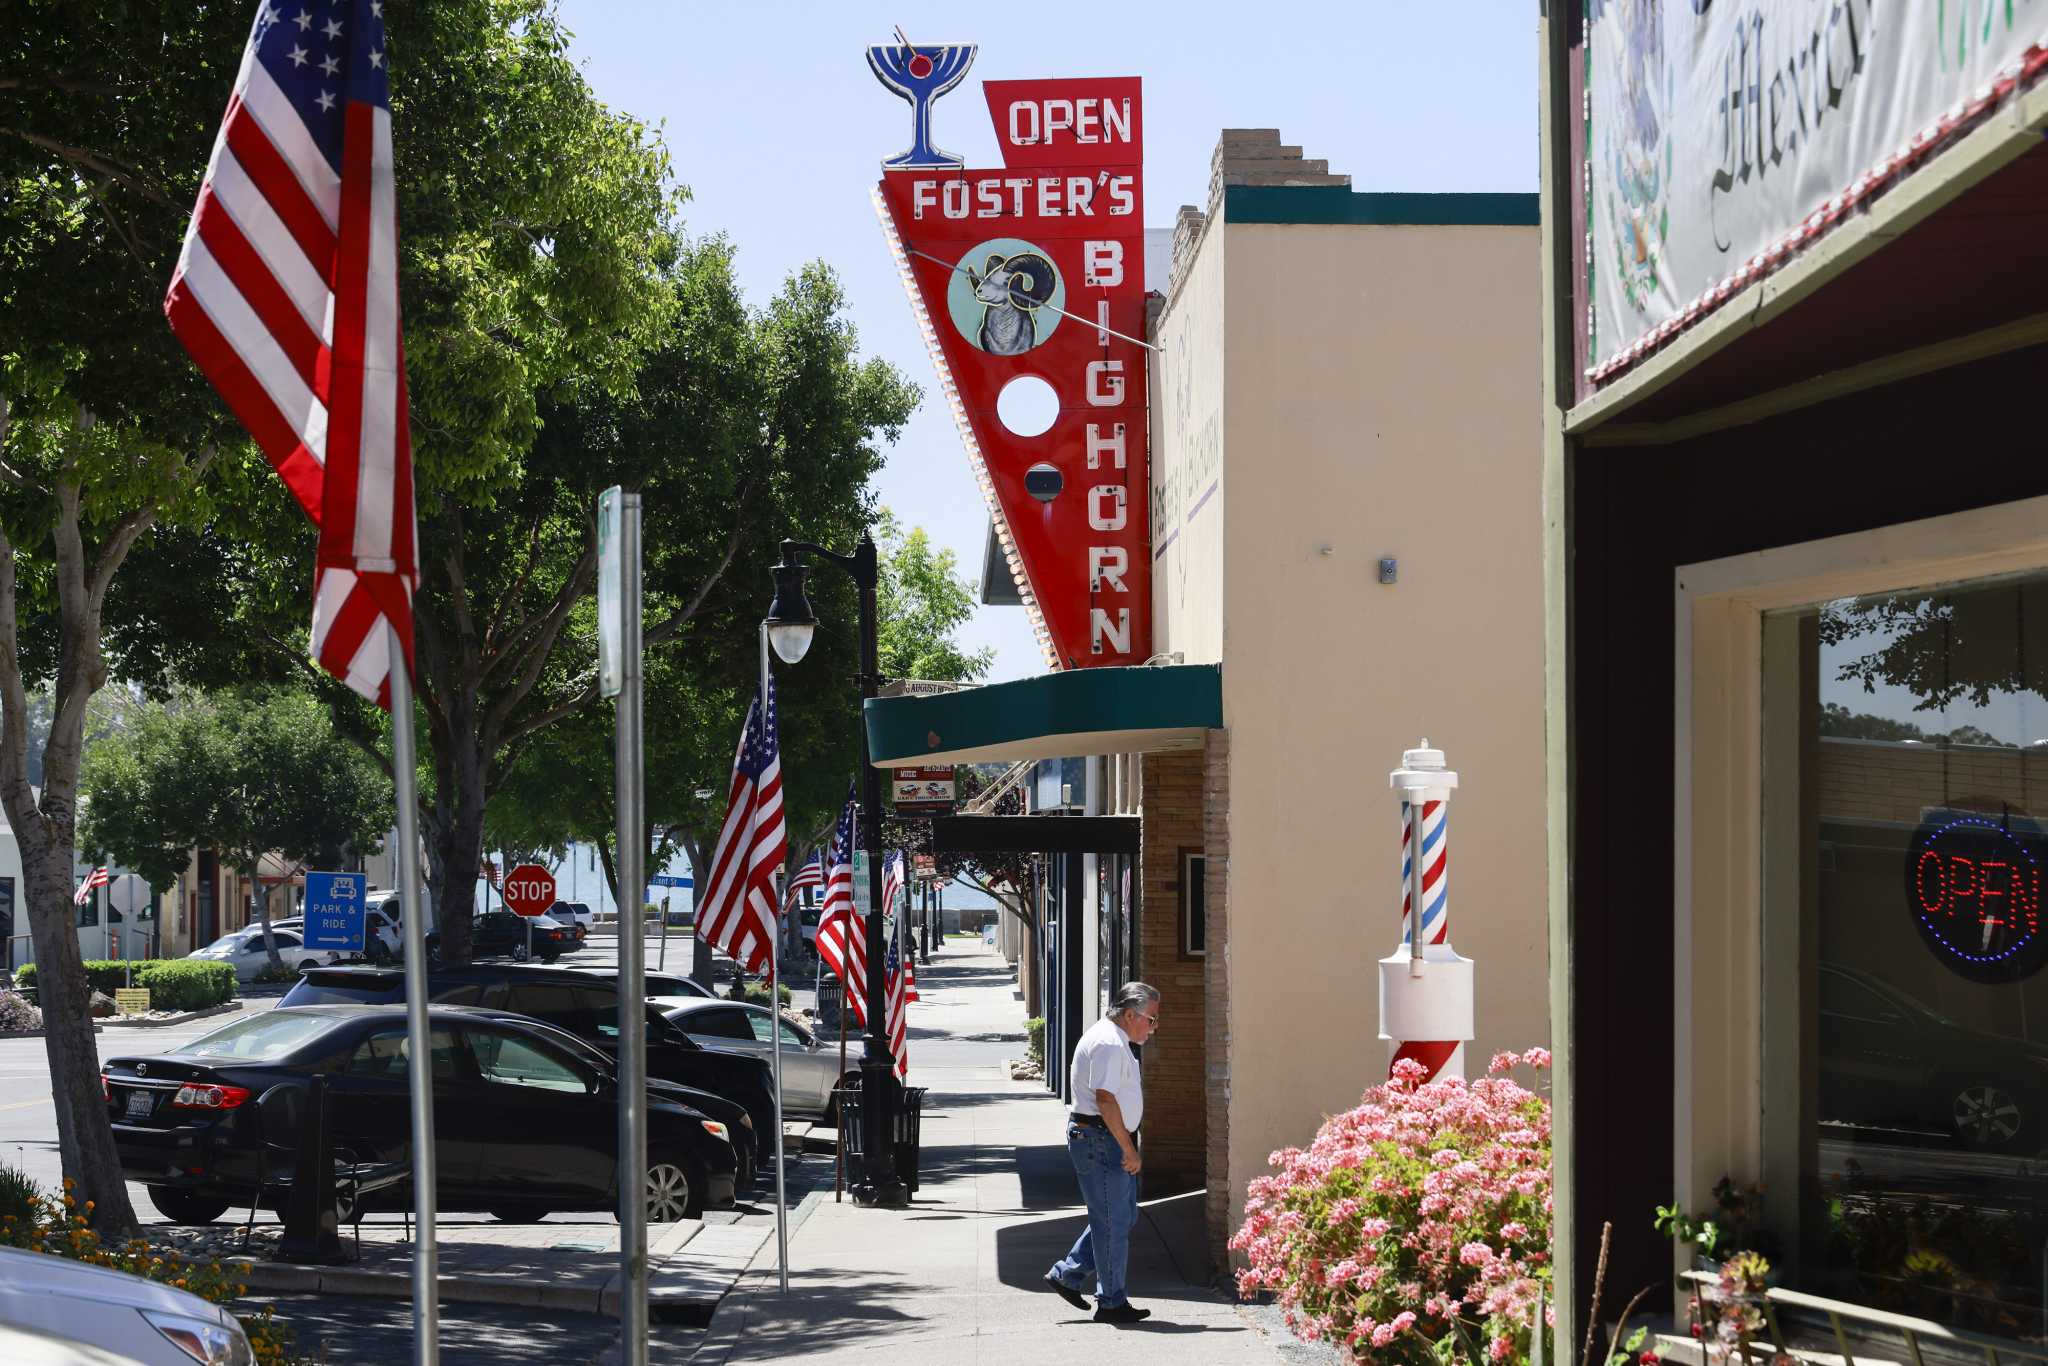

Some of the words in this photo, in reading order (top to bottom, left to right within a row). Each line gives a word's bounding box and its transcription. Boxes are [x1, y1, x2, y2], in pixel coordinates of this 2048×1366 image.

[1009, 98, 1131, 145] OPEN
[914, 171, 1133, 219] FOSTER'S
[1084, 240, 1130, 654] BIGHORN
[313, 904, 341, 914] PARK
[348, 905, 356, 915] &
[507, 881, 552, 901] STOP
[1917, 851, 2038, 934] OPEN
[322, 919, 346, 929] RIDE
